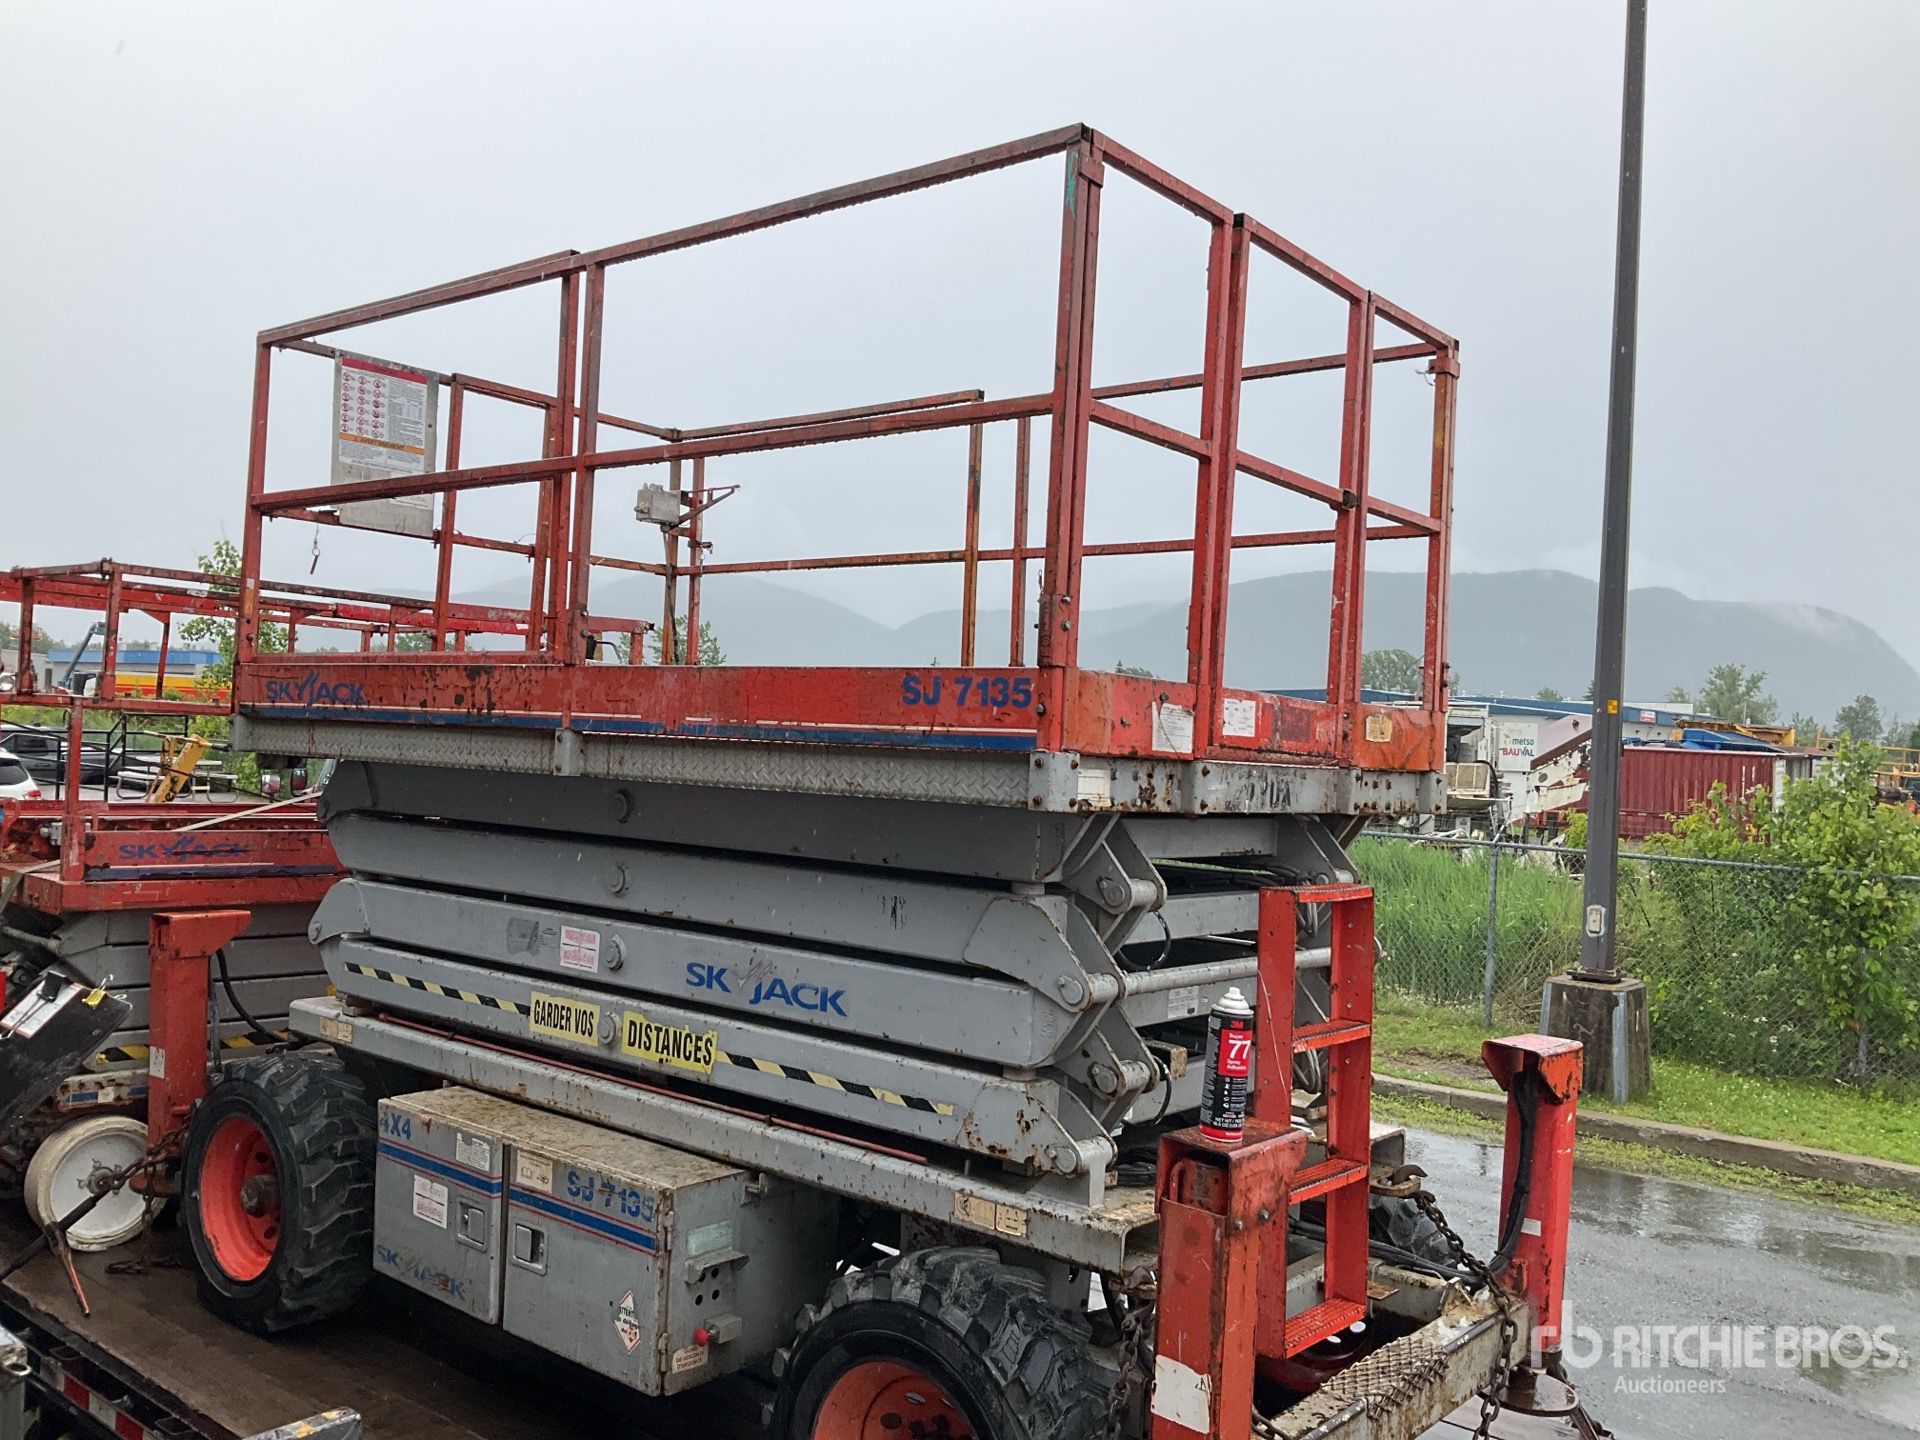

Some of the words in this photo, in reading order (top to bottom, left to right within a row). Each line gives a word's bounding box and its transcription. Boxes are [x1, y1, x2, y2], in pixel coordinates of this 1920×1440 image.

[265, 671, 367, 706] SKYJACK
[902, 674, 941, 705] SJ
[954, 676, 1031, 708] 7135
[1502, 747, 1534, 756] BAUVAL
[533, 999, 572, 1032] GARDER
[574, 1008, 594, 1038] VOS
[627, 1019, 713, 1066] DISTANCES
[1228, 1040, 1251, 1059] 77
[567, 1170, 595, 1201] SJ
[598, 1176, 655, 1222] 7135
